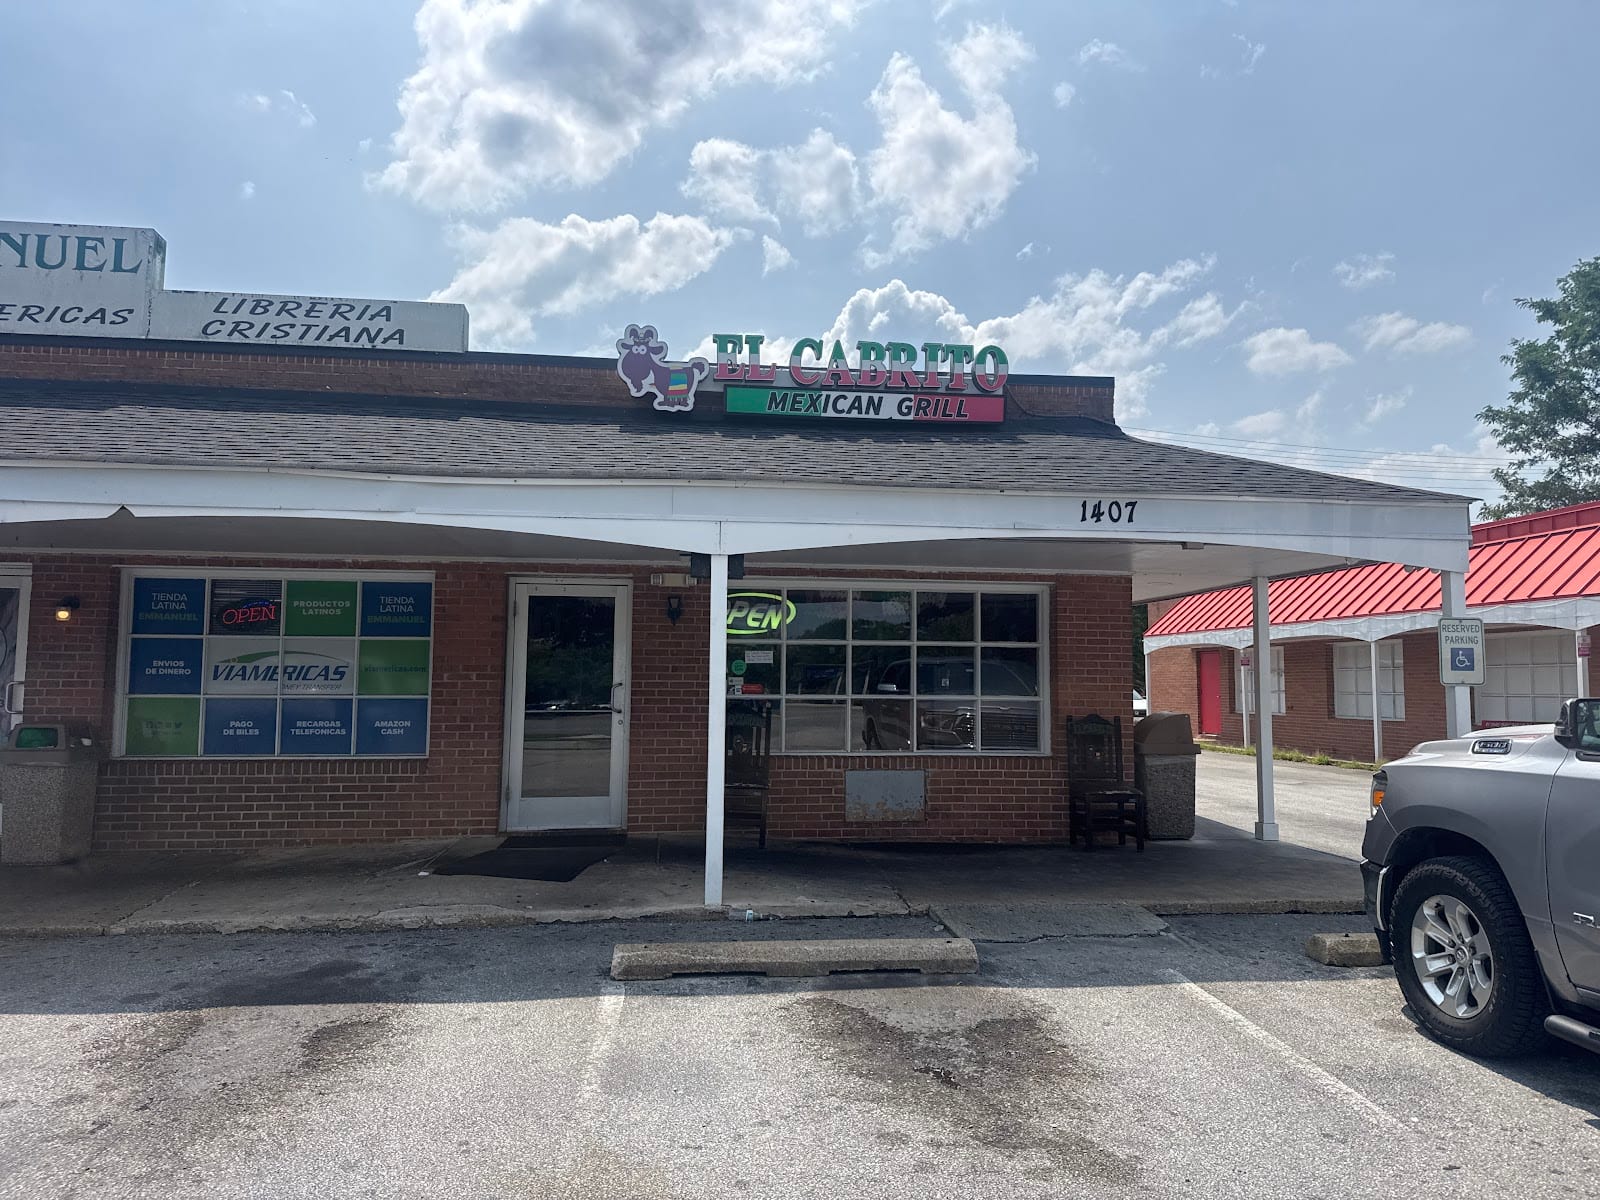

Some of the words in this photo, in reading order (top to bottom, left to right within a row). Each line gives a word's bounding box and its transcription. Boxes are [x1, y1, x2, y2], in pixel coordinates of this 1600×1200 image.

[0, 232, 142, 273] NUEL
[213, 297, 392, 322] LIBRERIA
[0, 304, 134, 325] ERICAS
[201, 319, 405, 345] CRISTIANA
[712, 333, 777, 382] EL
[790, 337, 1009, 392] CABRITO
[767, 391, 884, 416] MEXICAN
[896, 396, 969, 418] GRILL
[1080, 500, 1138, 523] 1407
[152, 592, 188, 601] TIENDA
[379, 596, 415, 604] TIENDA
[151, 601, 187, 610] LATINA
[379, 604, 414, 613] LATINA
[138, 612, 198, 621] EMMANUEL
[222, 605, 277, 625] OPEN
[367, 615, 425, 624] EMMANUEL
[727, 600, 783, 630] PEN
[1442, 624, 1480, 633] RESERVED
[1444, 636, 1479, 645] PARKING
[145, 667, 157, 675] DE
[158, 667, 192, 675] DINERO
[212, 664, 349, 681] VIAMERICAS
[229, 720, 253, 728] PAGO
[296, 720, 341, 728] RECARGAS
